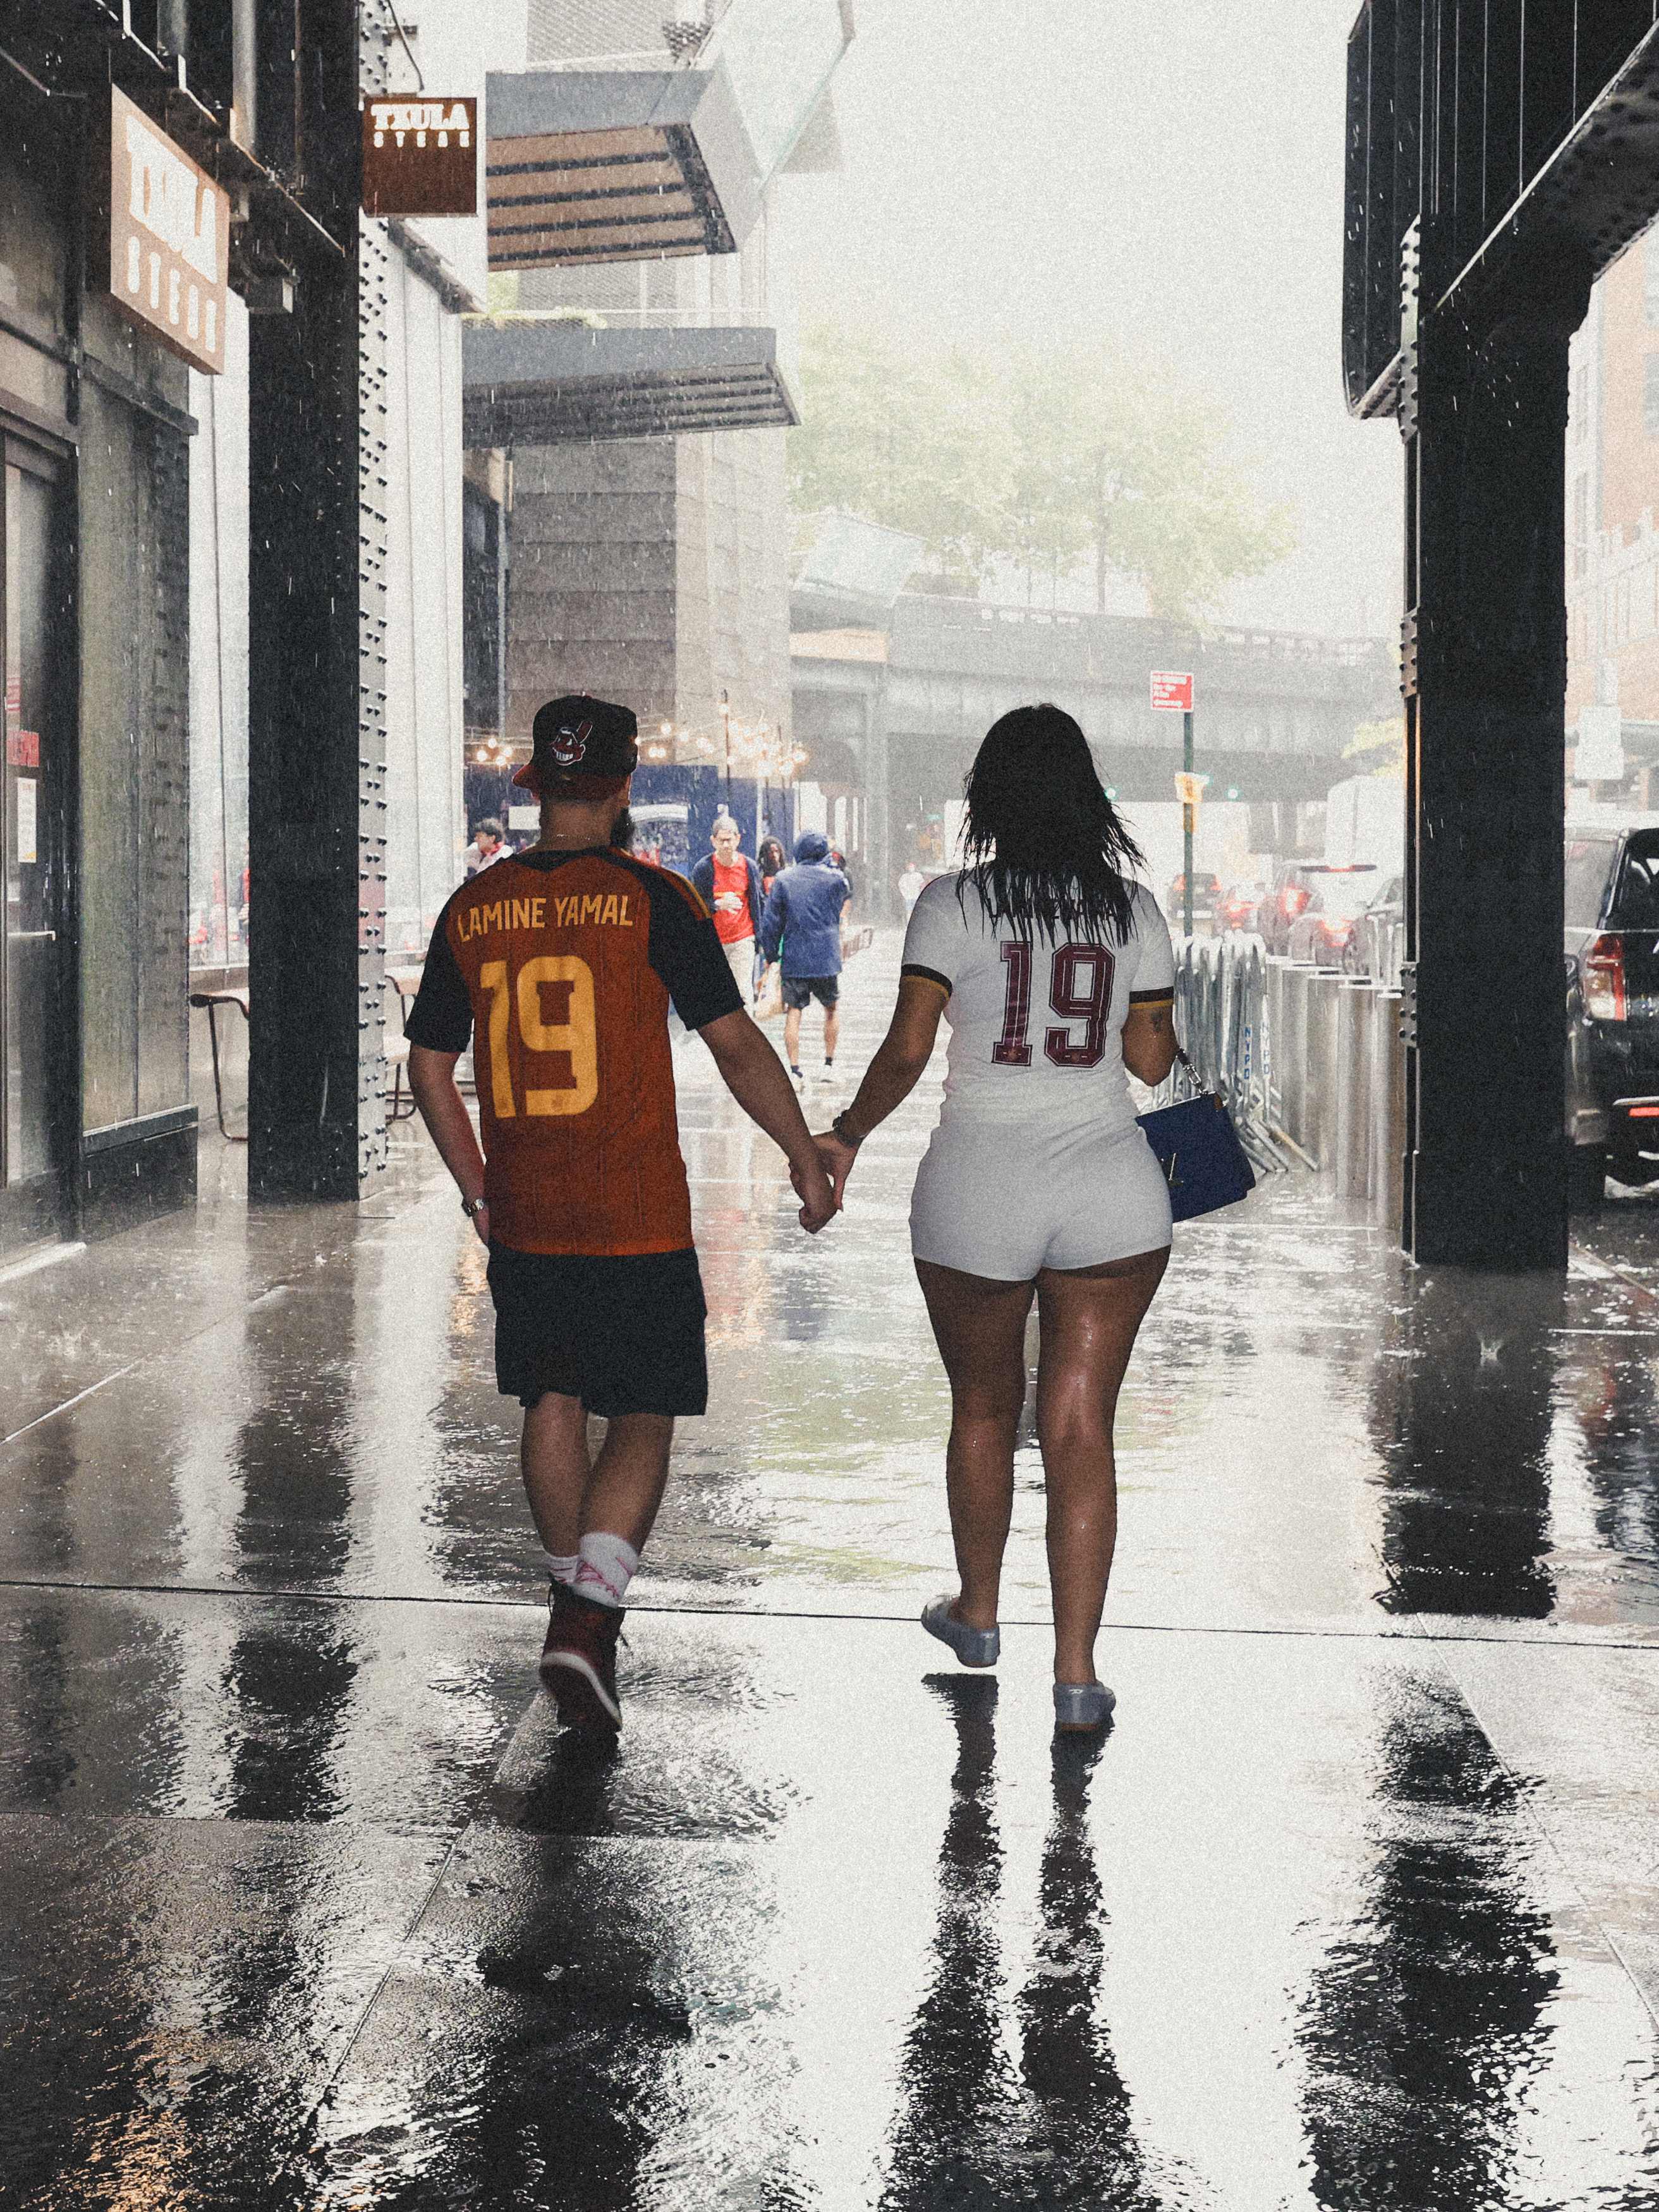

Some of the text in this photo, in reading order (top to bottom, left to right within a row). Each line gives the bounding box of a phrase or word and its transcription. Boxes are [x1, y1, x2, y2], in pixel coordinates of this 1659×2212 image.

[371, 103, 470, 130] TXULA
[457, 894, 633, 942] LAMINE YAMAL
[991, 940, 1116, 1069] 19
[480, 955, 599, 1119] 19
[1243, 1026, 1251, 1079] NYPD
